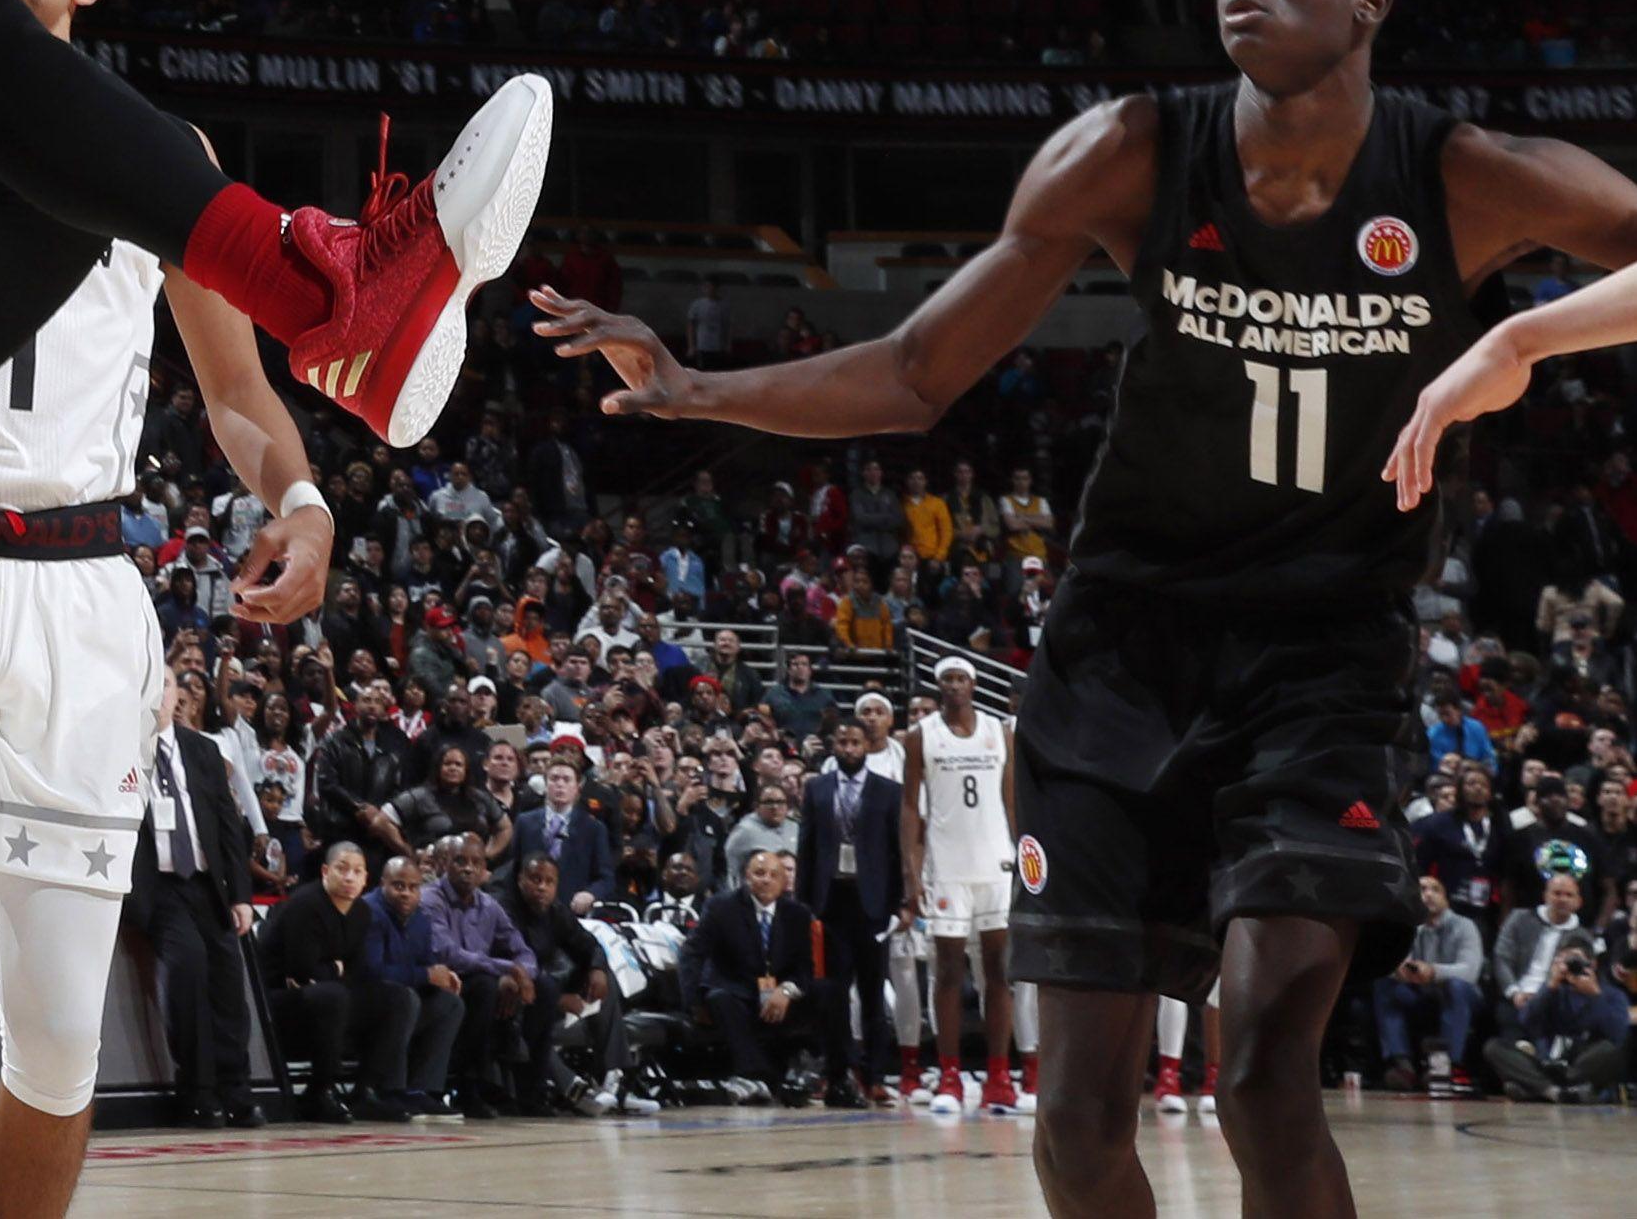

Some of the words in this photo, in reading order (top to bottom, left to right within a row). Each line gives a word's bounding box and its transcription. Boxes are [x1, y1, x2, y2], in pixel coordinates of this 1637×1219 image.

[160, 44, 250, 86] CHRIS
[258, 53, 382, 93] MULLIN
[584, 66, 687, 107] SMITH
[775, 77, 884, 115] DANNY
[892, 82, 1053, 118] MANNING
[1525, 84, 1635, 122] CHRIS
[1162, 268, 1433, 329] McDONALD'S
[1177, 311, 1234, 348] ALL
[1239, 324, 1411, 359] AMERICAN
[1243, 358, 1329, 494] 11
[963, 775, 979, 809] 8
